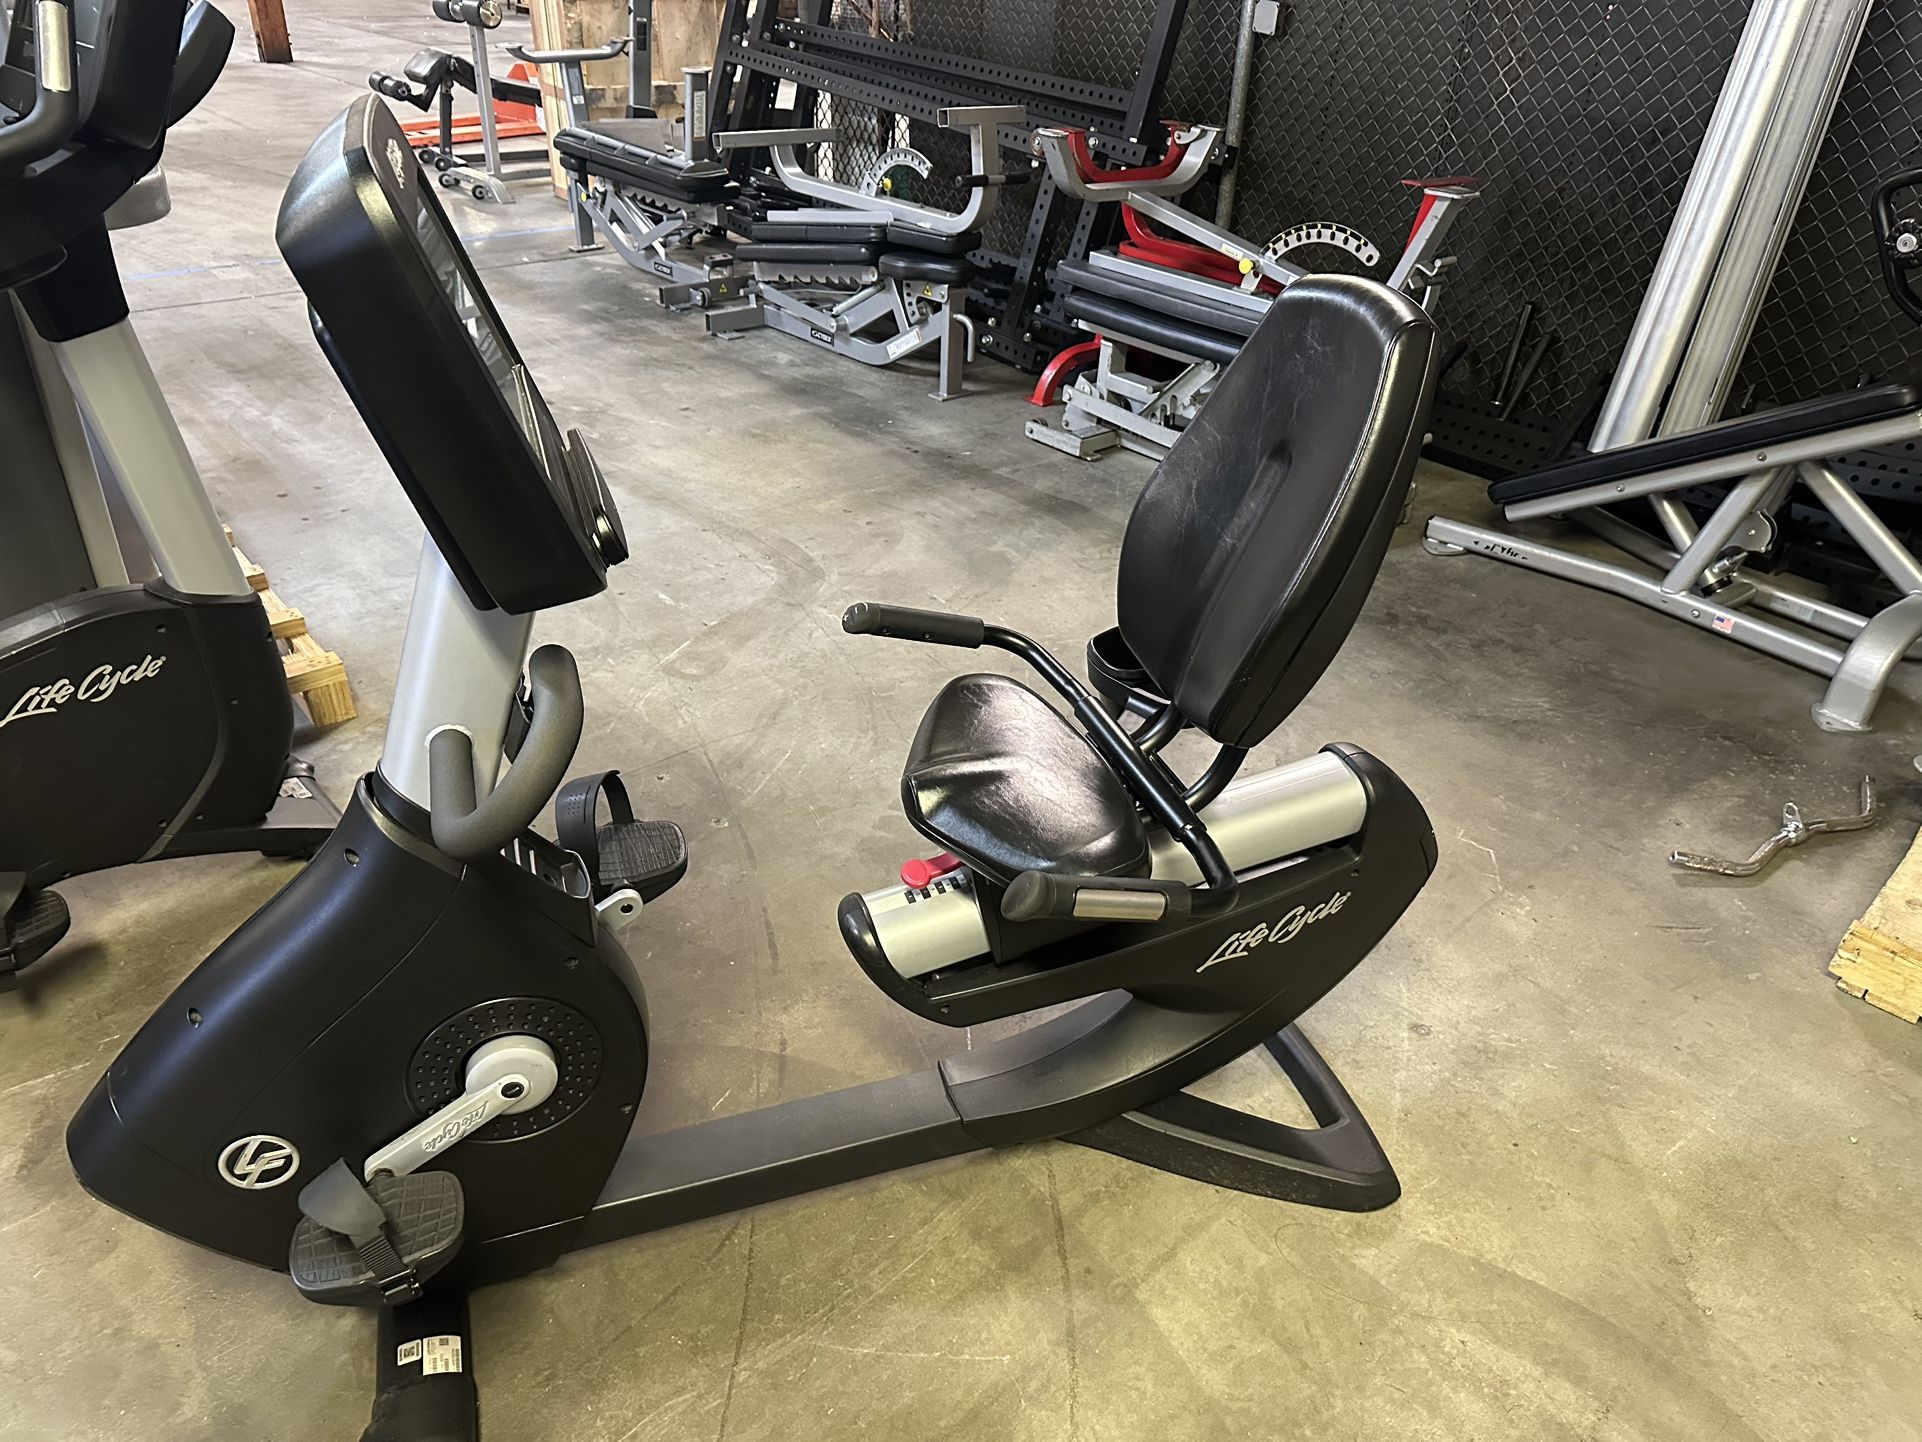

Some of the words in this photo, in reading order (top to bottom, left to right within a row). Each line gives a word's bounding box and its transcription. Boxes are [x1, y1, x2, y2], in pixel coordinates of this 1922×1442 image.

[0, 678, 75, 727] Life
[77, 655, 164, 702] Cycle
[1196, 922, 1269, 973] Life
[1268, 891, 1348, 944] Cycle
[424, 1121, 461, 1151] Cycle
